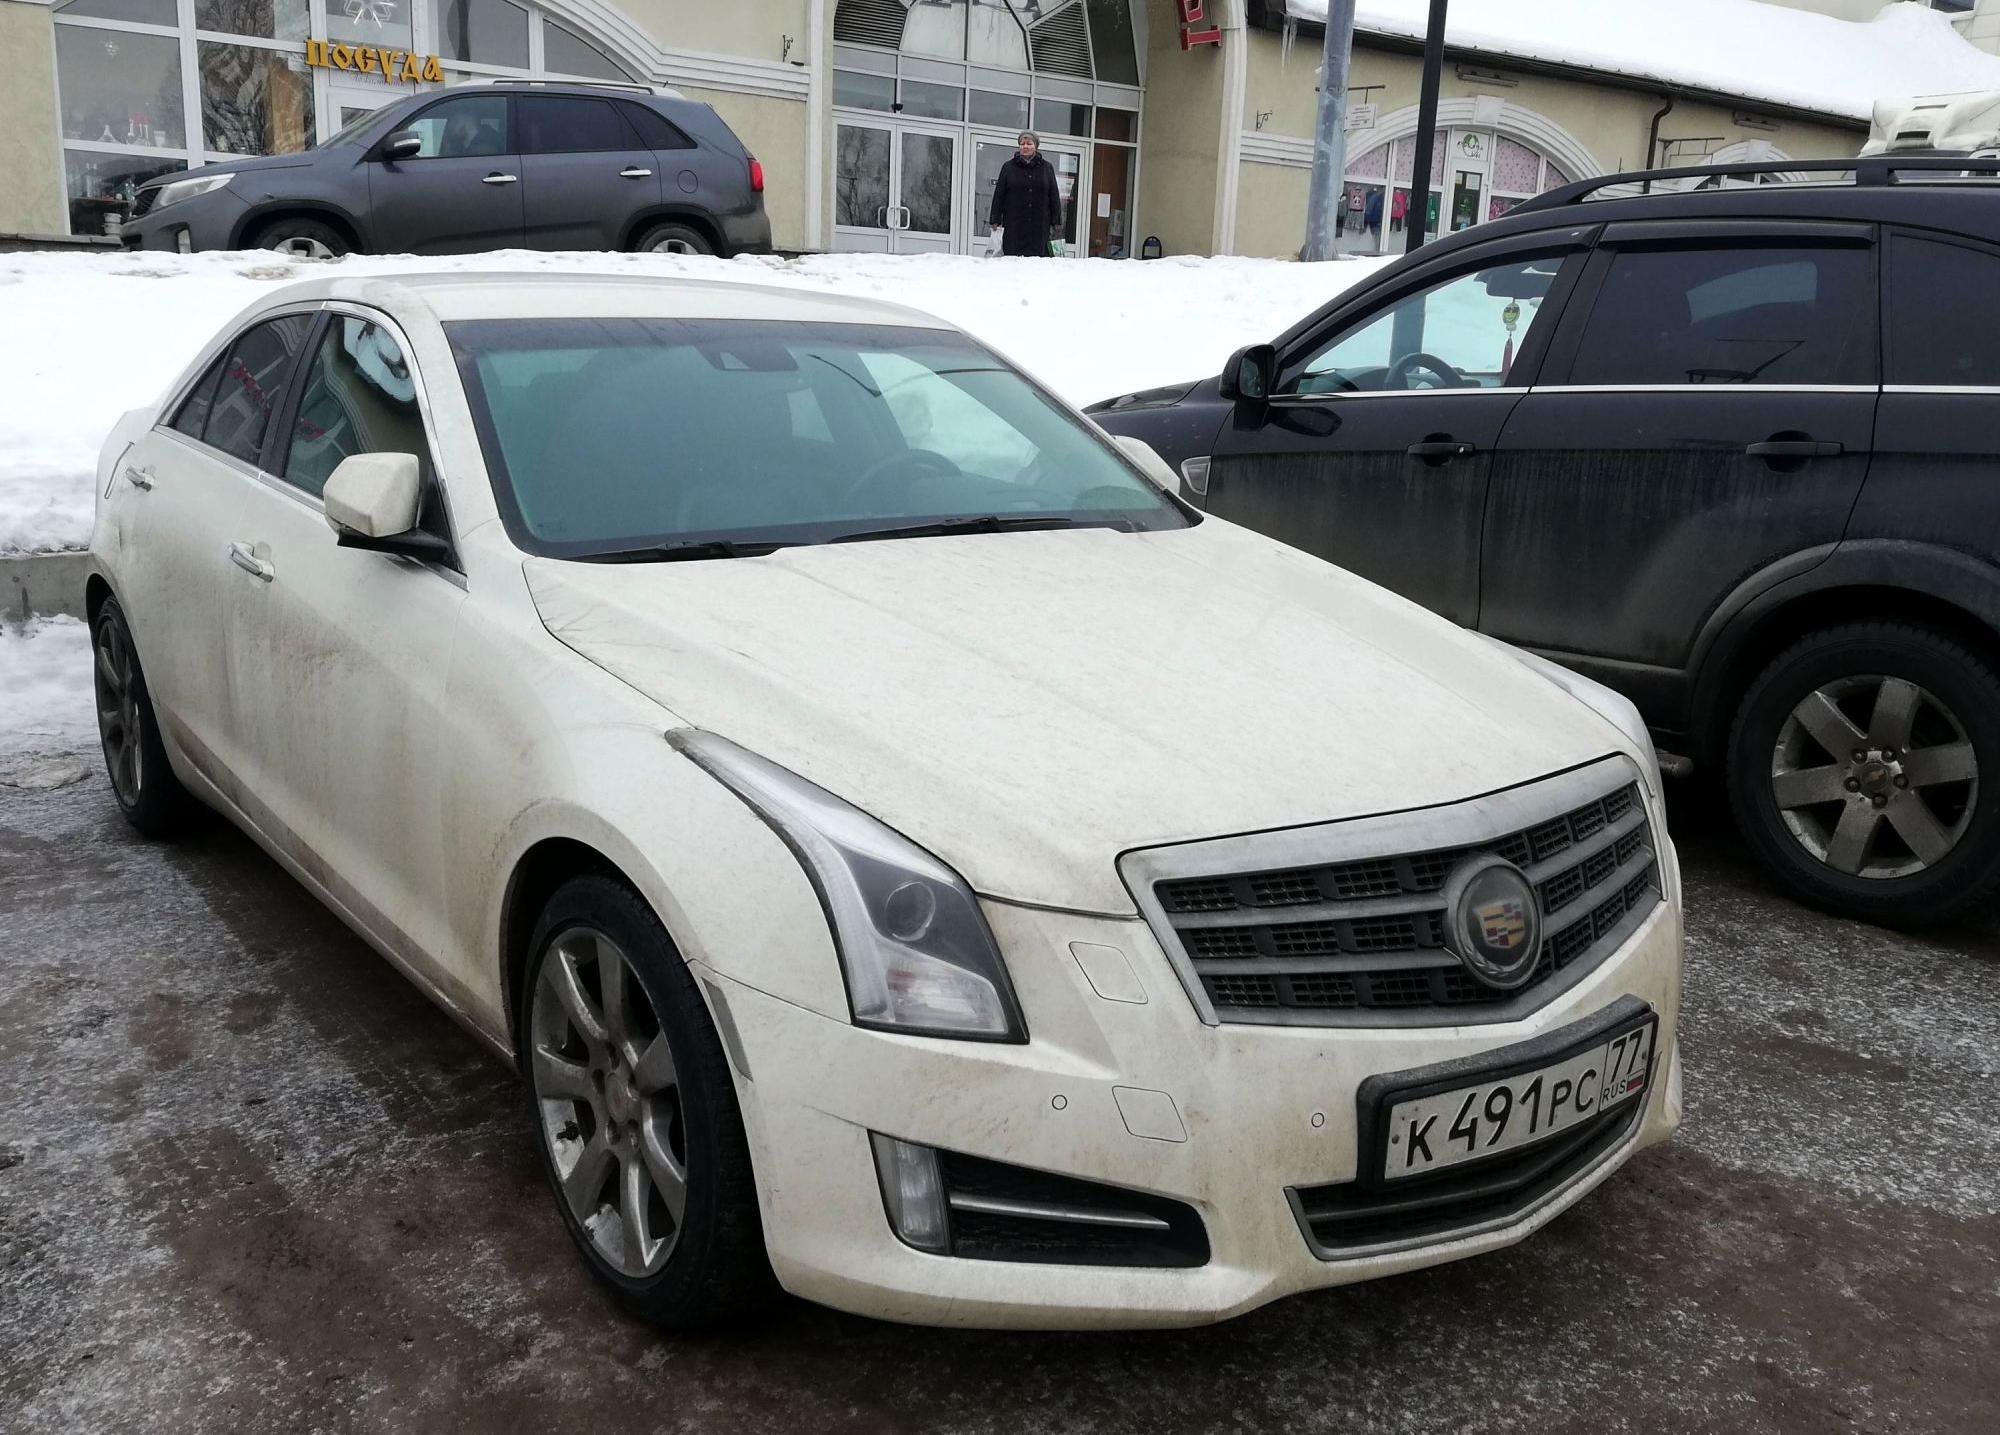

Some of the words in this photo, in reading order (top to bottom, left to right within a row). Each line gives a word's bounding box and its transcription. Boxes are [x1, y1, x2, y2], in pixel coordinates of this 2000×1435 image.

[305, 38, 443, 83] ПОСУДА
[1611, 1030, 1643, 1083] 77
[1602, 1082, 1627, 1106] RUS
